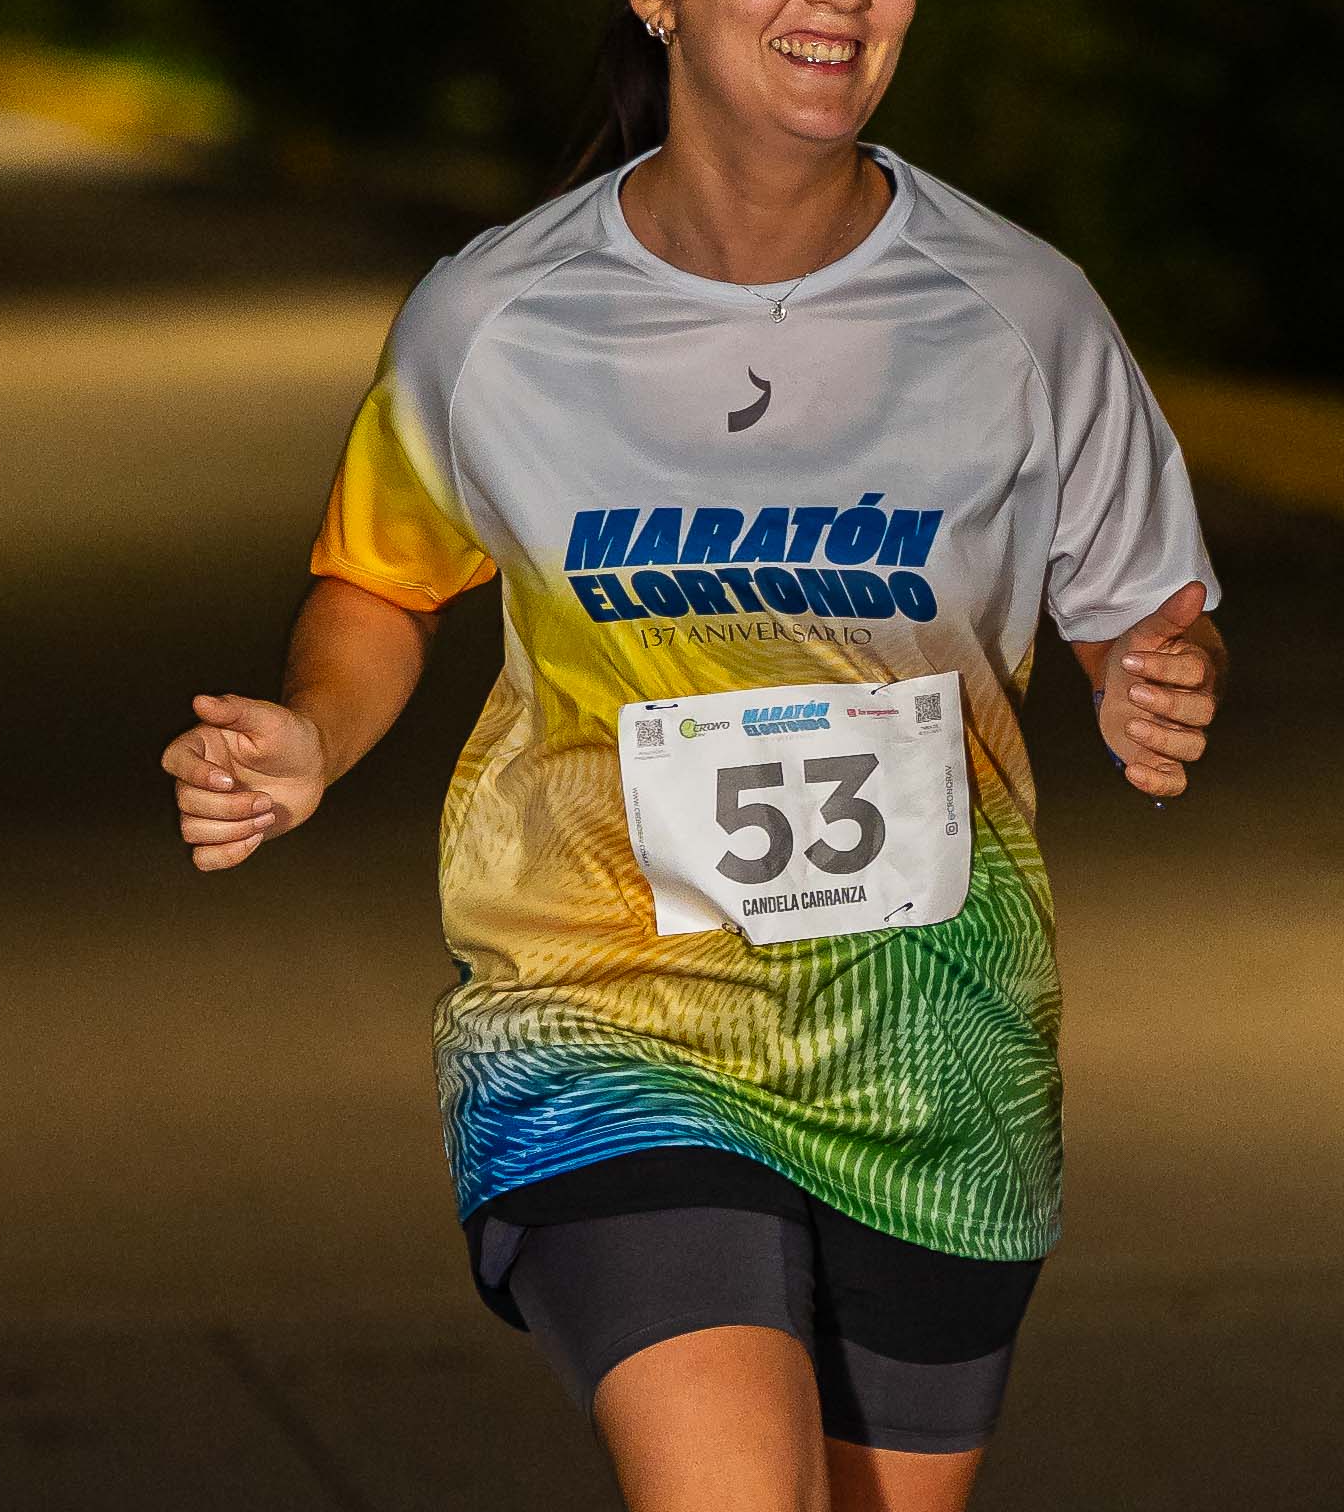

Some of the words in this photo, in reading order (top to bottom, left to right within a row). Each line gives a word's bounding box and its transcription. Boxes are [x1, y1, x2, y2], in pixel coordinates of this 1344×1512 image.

[564, 492, 944, 571] MARATÓN
[568, 567, 938, 623] ELORTONDO
[640, 626, 676, 648] 137
[687, 622, 872, 646] ANIVERSARIO
[741, 700, 830, 724] MARATÓN
[742, 717, 831, 736] ELORTONDO
[715, 754, 886, 885] 53
[742, 893, 800, 917] CANDELA
[801, 885, 868, 910] CARRANZA
